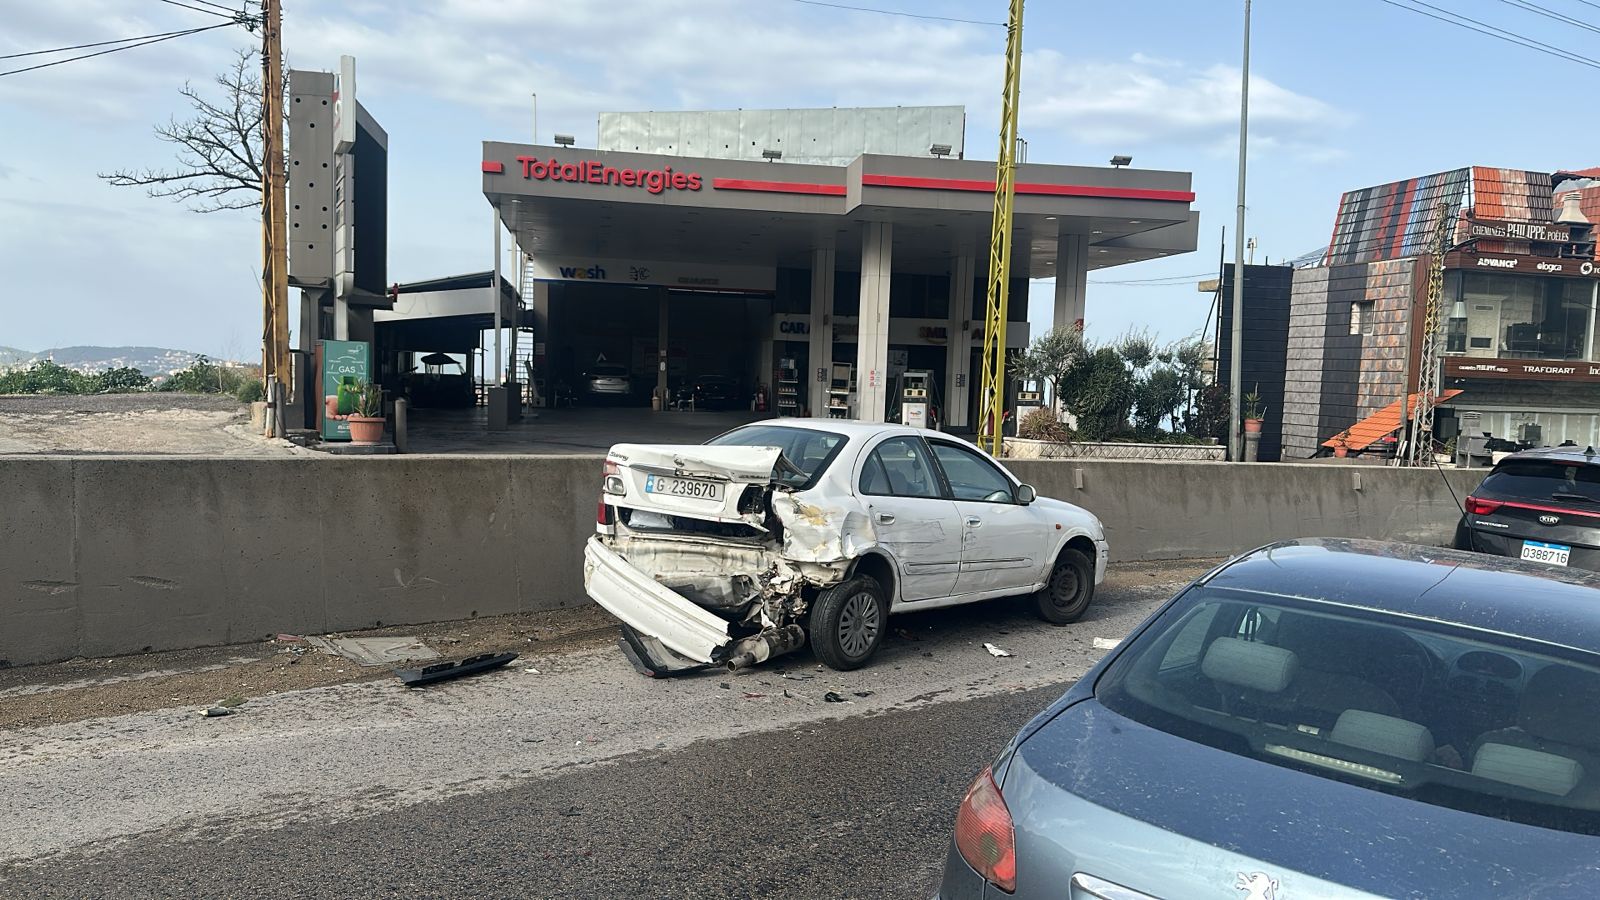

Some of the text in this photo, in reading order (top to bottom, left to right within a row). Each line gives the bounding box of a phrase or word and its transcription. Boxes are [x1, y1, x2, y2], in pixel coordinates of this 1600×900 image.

[516, 155, 702, 194] TotalEnergies
[1507, 223, 1547, 239] PHILIPPE
[1477, 257, 1515, 268] ADVANCE
[560, 264, 606, 279] wash
[780, 320, 805, 335] CAR
[338, 365, 356, 374] GAS
[1523, 365, 1576, 374] TRAFORART
[609, 451, 629, 462] Sunny
[656, 478, 717, 498] G 239670
[1540, 515, 1559, 524] KIA
